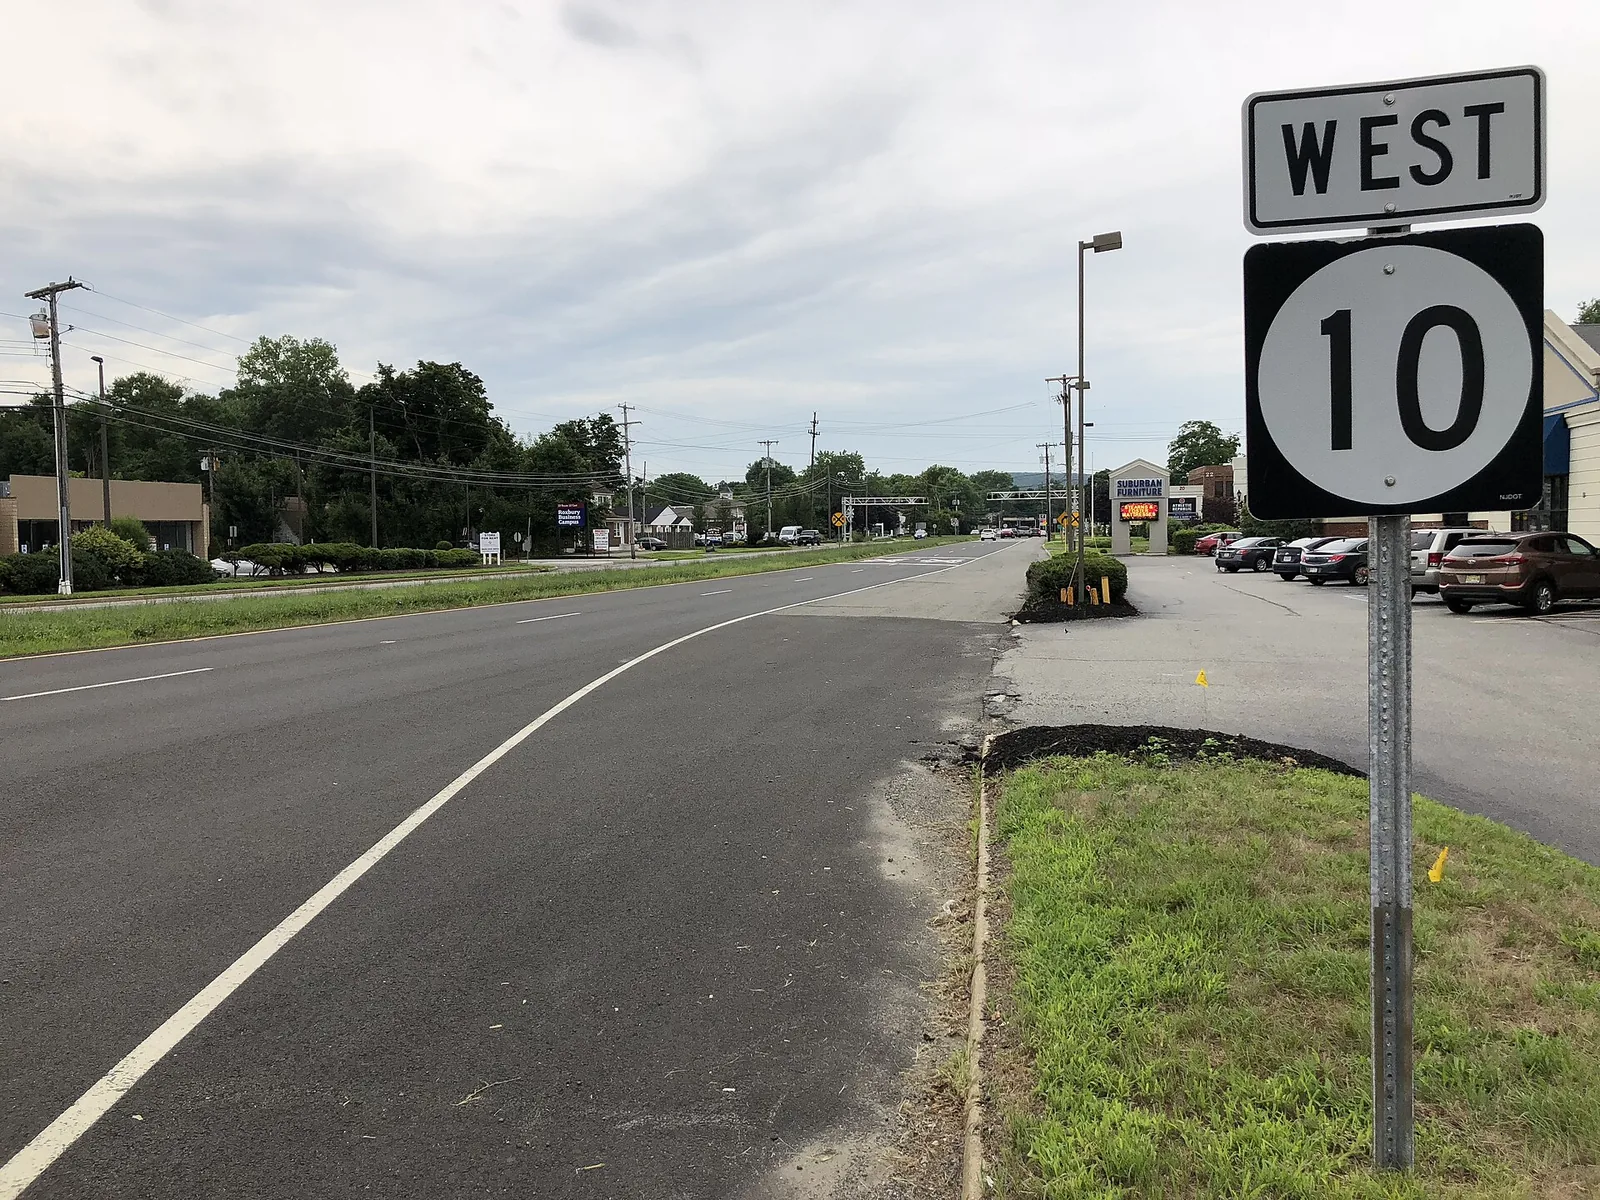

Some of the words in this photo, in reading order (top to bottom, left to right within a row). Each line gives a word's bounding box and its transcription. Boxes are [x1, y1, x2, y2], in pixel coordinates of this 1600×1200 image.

[1281, 102, 1505, 196] WEST
[1320, 304, 1485, 452] 10
[1117, 479, 1162, 488] SUBURBAN
[1117, 487, 1162, 497] FURNITURE
